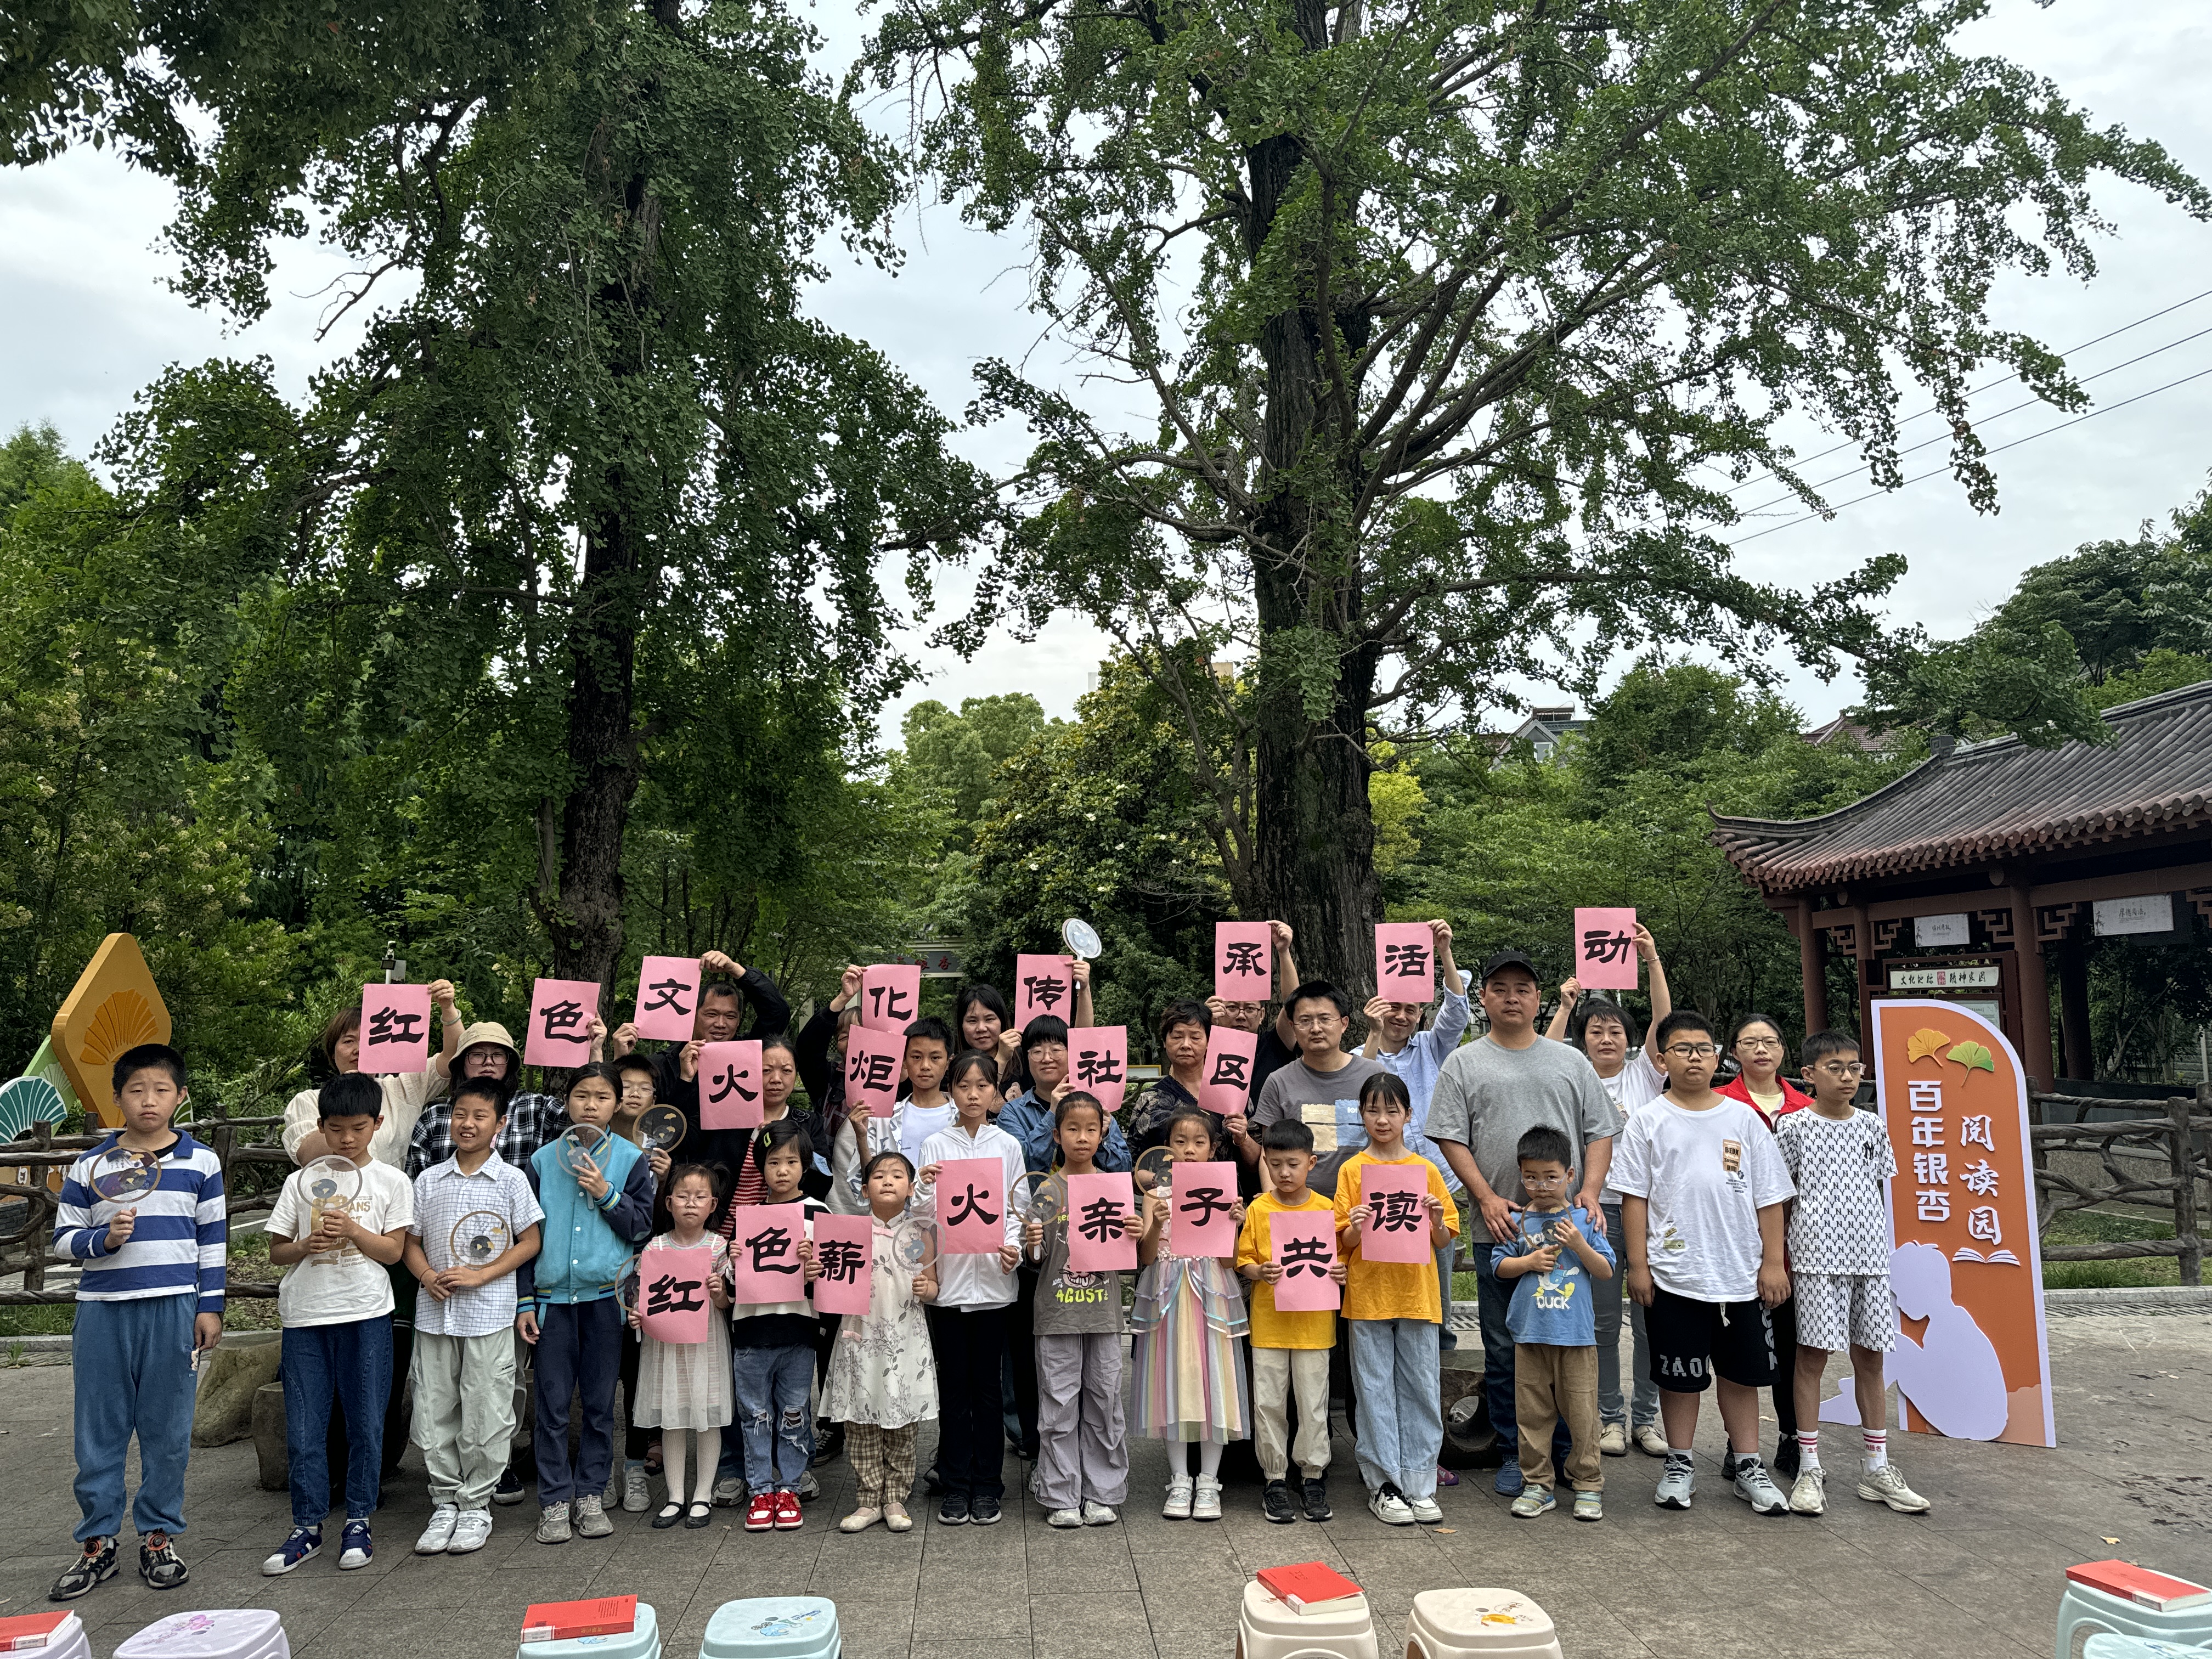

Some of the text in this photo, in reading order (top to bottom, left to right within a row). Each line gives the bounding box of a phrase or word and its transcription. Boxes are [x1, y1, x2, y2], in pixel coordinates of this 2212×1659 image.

[1223, 943, 1267, 977] 承
[1385, 945, 1429, 977] 活
[1584, 930, 1631, 964] 动
[644, 979, 691, 1015] 文
[869, 986, 912, 1020] 化
[1024, 975, 1067, 1010] 传
[369, 1007, 424, 1046] 红
[540, 1001, 589, 1043] 色
[709, 1064, 758, 1103] 火
[850, 1051, 895, 1092] 炬
[1077, 1050, 1122, 1088] 社
[1210, 1053, 1249, 1091] 区
[1908, 1080, 1951, 1222] 百年银杏
[1959, 1115, 2002, 1245] 阅读园
[947, 1184, 998, 1226] 火
[1079, 1198, 1124, 1243] 亲
[1180, 1188, 1232, 1226] 子
[1368, 1190, 1422, 1232] 读
[746, 1227, 800, 1274] 色
[819, 1240, 865, 1284] 薪
[1281, 1237, 1333, 1278] 共
[647, 1274, 704, 1316] 红
[1055, 1288, 1104, 1304] AGUST
[1536, 1296, 1571, 1310] DUCK
